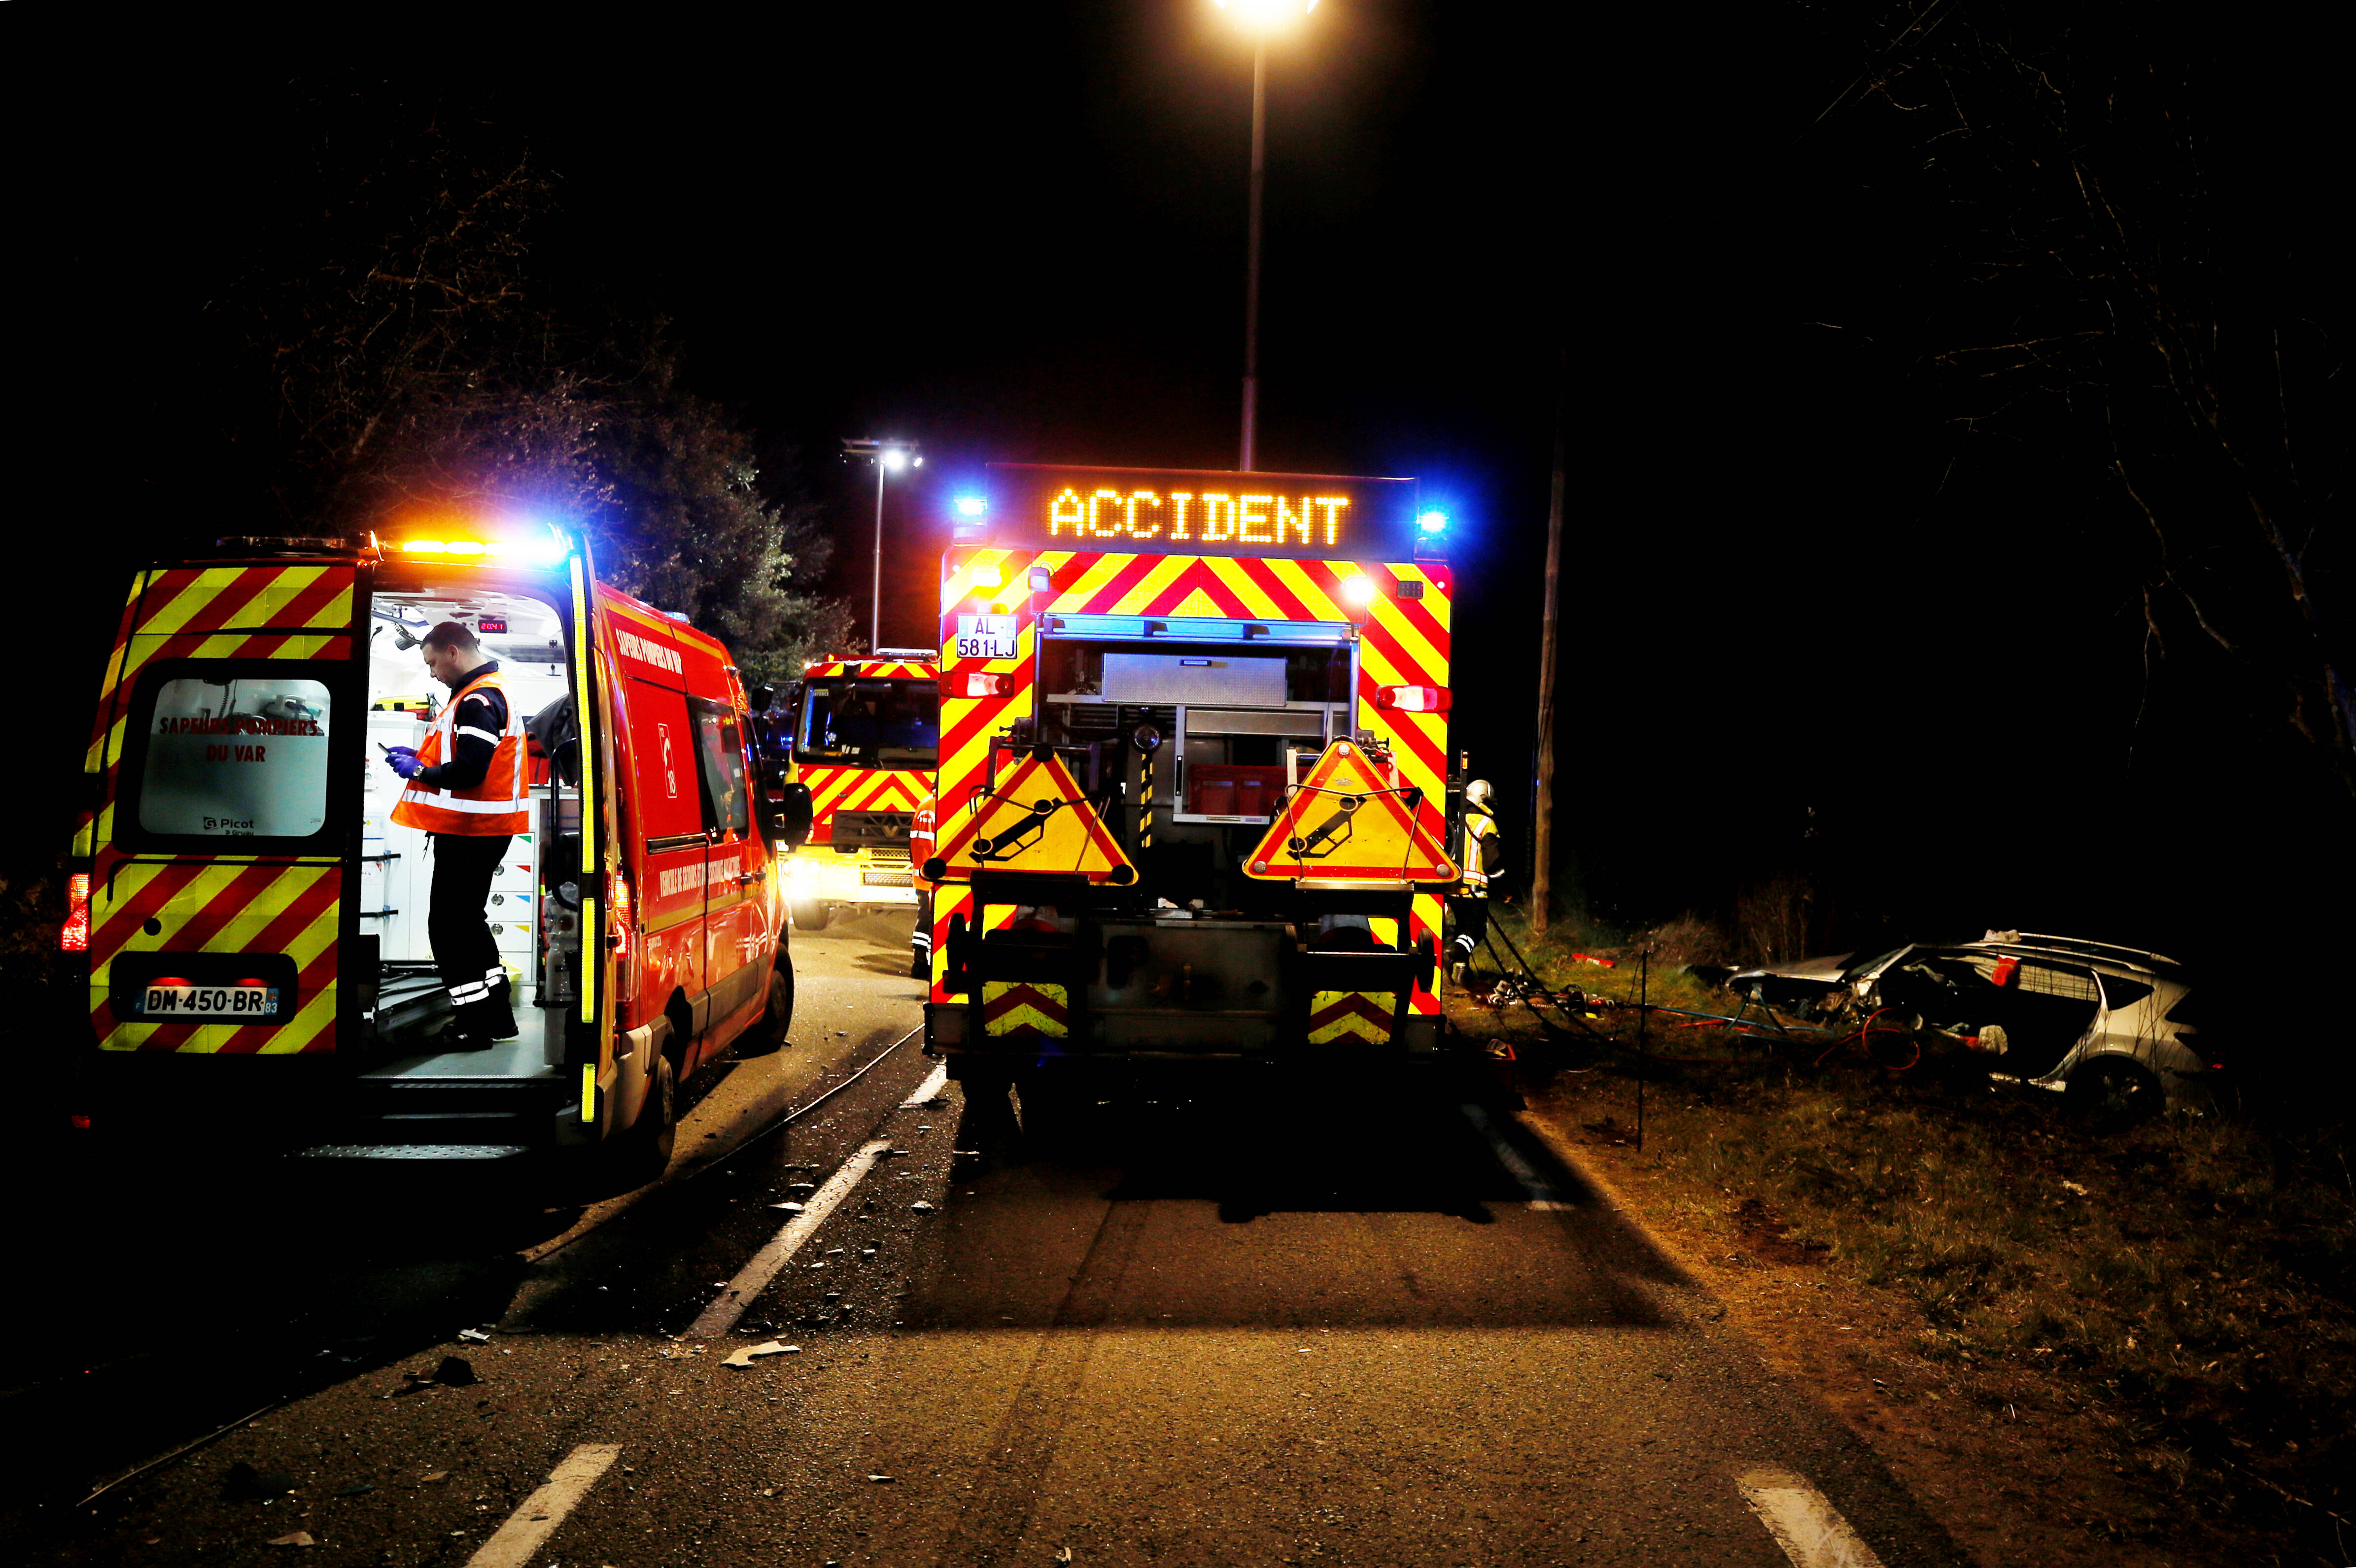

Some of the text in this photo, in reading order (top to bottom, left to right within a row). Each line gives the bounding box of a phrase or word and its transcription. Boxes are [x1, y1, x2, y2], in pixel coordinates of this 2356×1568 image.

[1050, 489, 1348, 545] ACCIDENT
[616, 628, 643, 662] SAPEURS
[639, 637, 667, 670] POMPIERS
[959, 639, 1014, 656] 581-LJ
[160, 717, 318, 736] SAPEURS POMPIERS
[207, 744, 266, 762] DU VAR
[667, 770, 676, 794] 18
[221, 818, 254, 829] Picot
[147, 990, 263, 1012] DM-450-BR
[265, 1002, 277, 1013] 83
